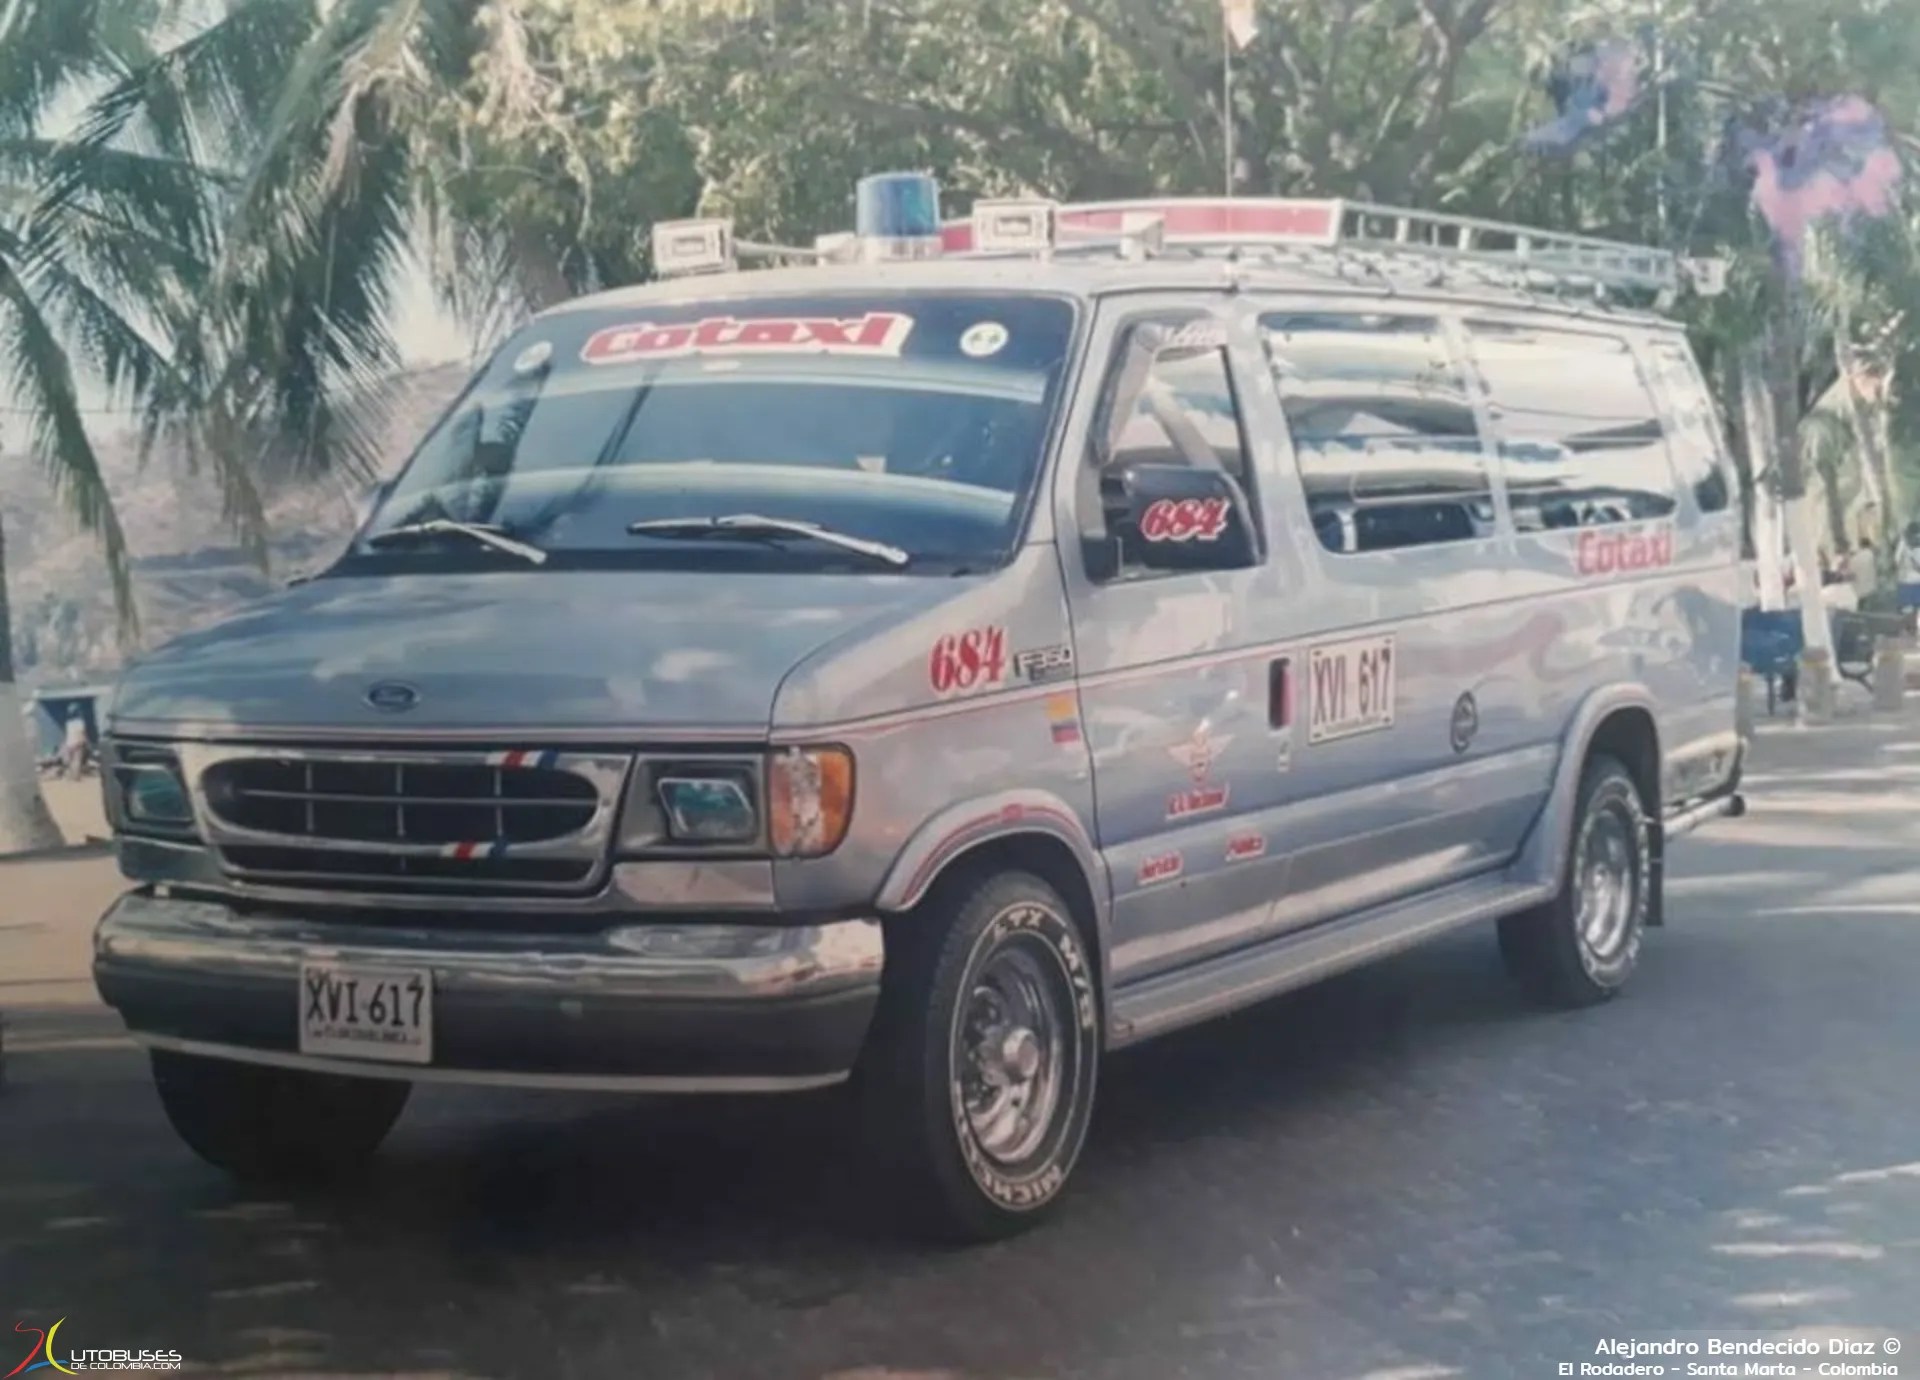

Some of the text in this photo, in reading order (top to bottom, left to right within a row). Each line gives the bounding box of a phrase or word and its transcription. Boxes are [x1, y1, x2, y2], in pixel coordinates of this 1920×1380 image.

[1141, 498, 1230, 541] 684
[1578, 526, 1671, 575] Cotaxi
[930, 624, 1006, 693] 684
